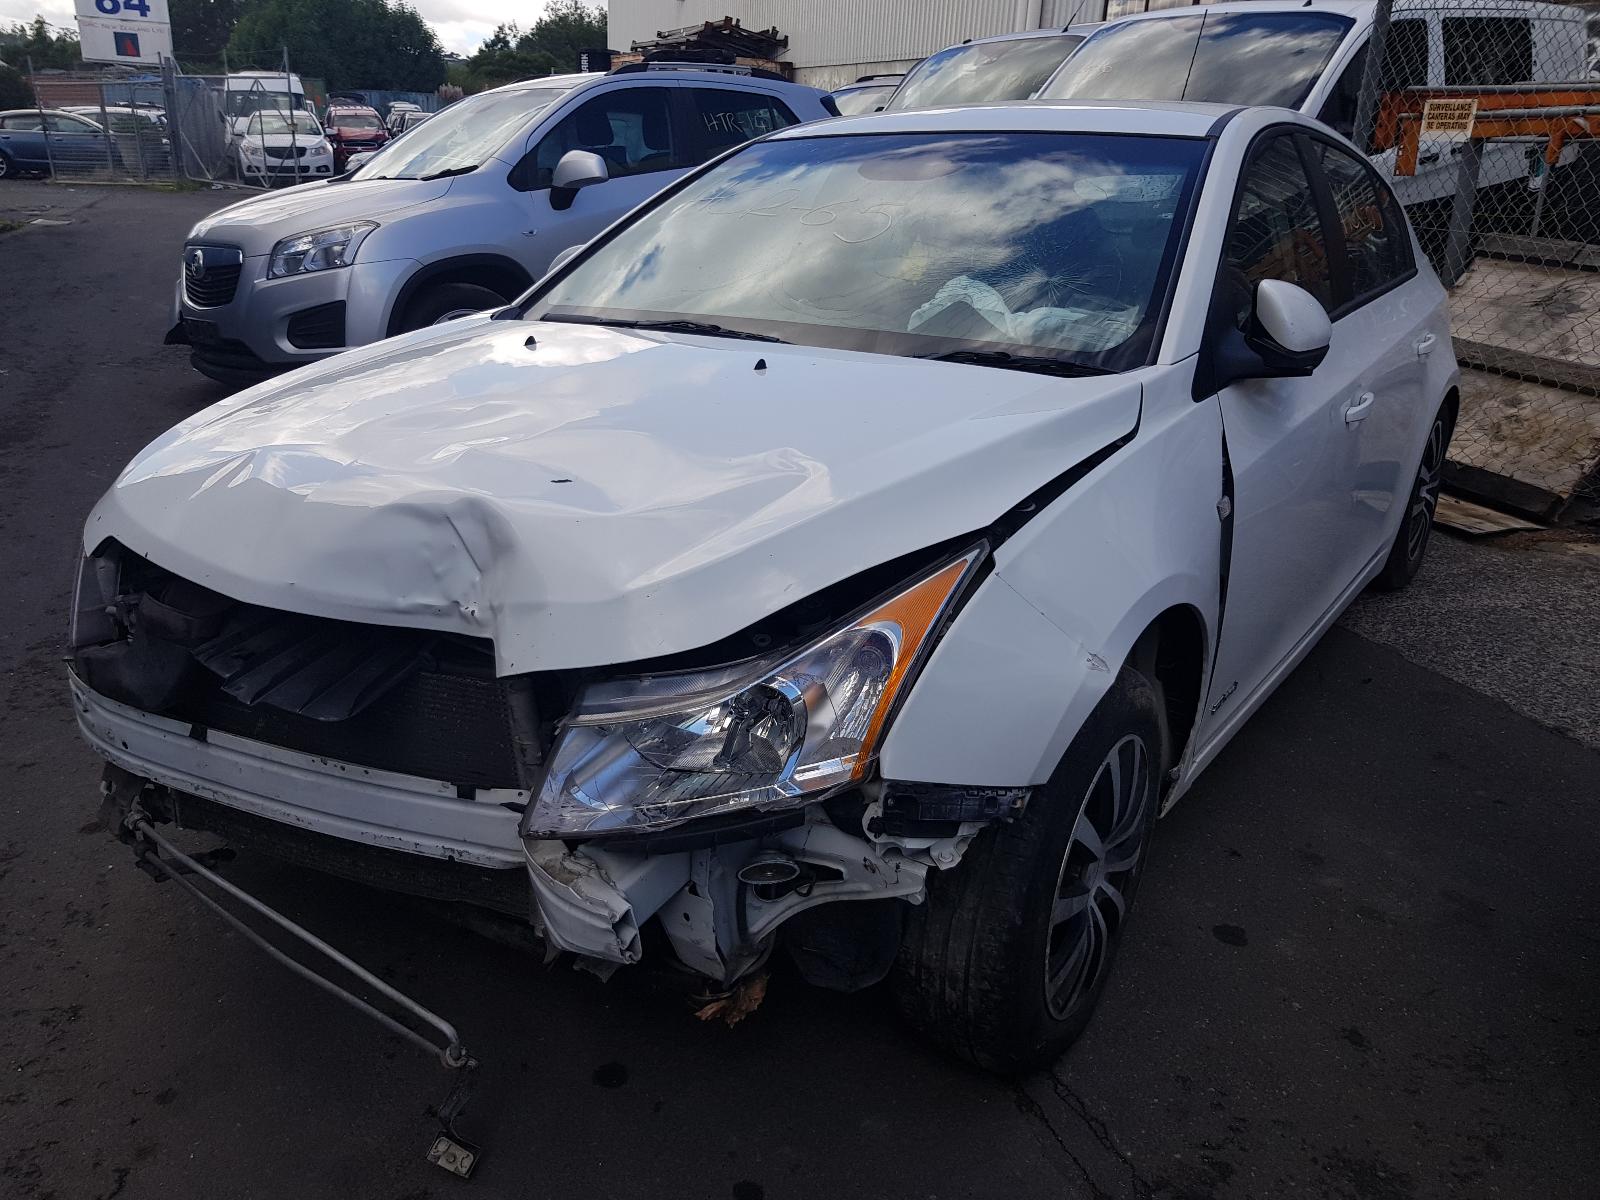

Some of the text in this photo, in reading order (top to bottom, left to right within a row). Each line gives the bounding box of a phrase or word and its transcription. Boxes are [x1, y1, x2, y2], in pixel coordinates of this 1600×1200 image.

[1428, 103, 1472, 112] SURVEILLANCE
[1427, 112, 1471, 121] CAMERAS MAY
[1426, 121, 1468, 130] BE OPERATING
